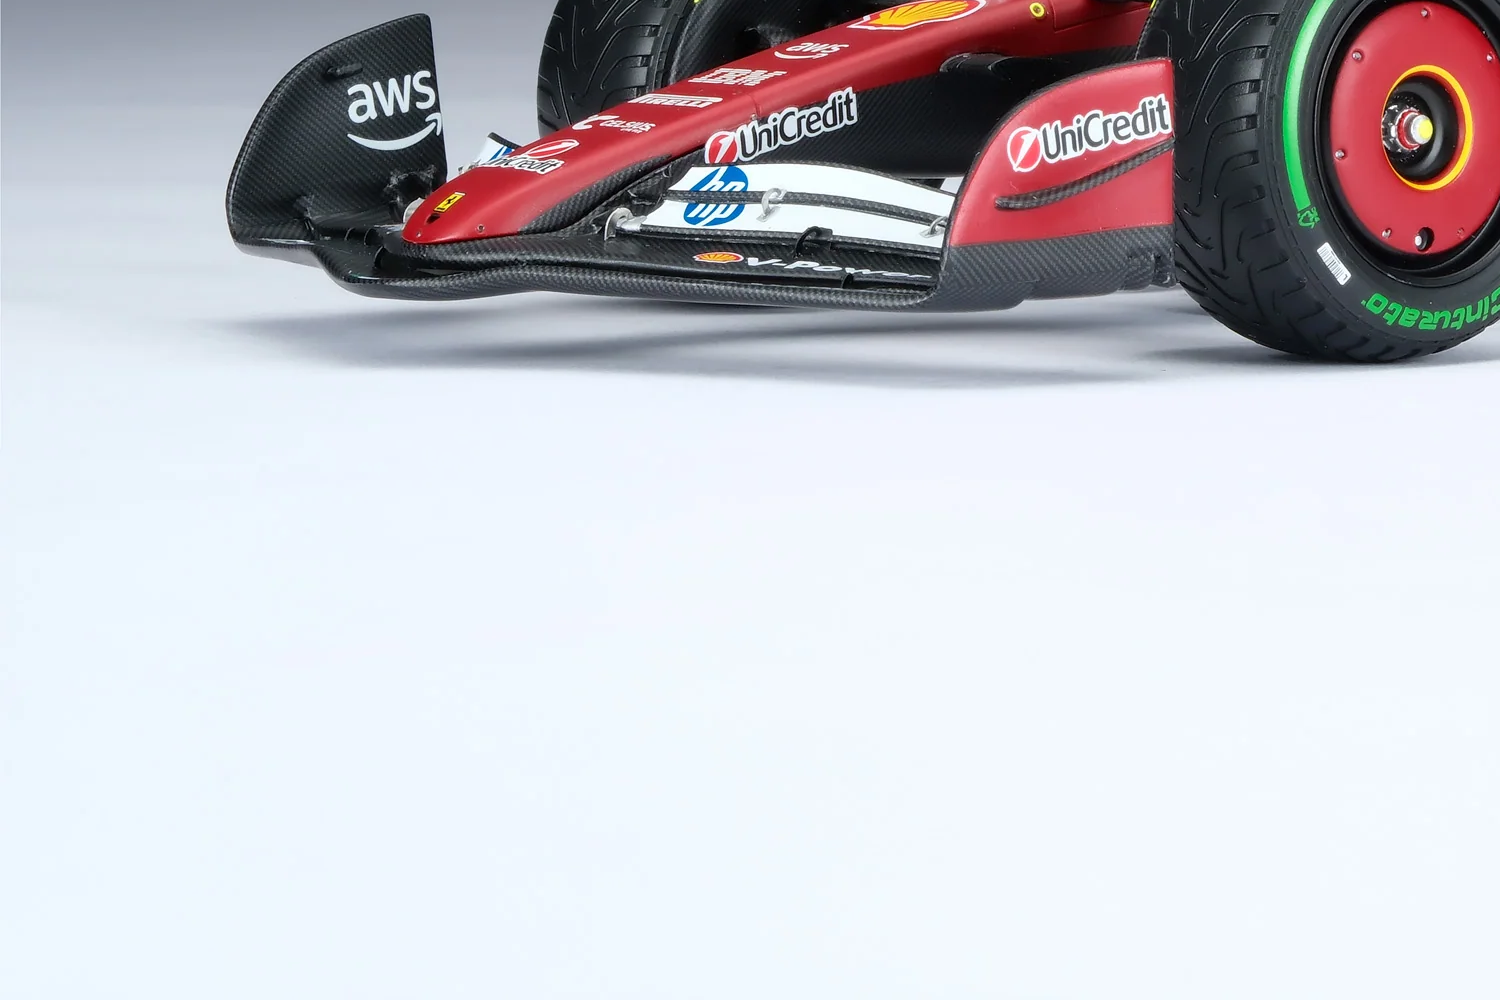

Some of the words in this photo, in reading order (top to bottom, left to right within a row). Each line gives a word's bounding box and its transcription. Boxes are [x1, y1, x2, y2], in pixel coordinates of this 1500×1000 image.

[347, 70, 436, 124] aws
[629, 94, 722, 108] PIRELLI
[740, 92, 855, 159] UniCredit
[1042, 98, 1169, 160] UniCredit
[747, 257, 932, 279] V-Power
